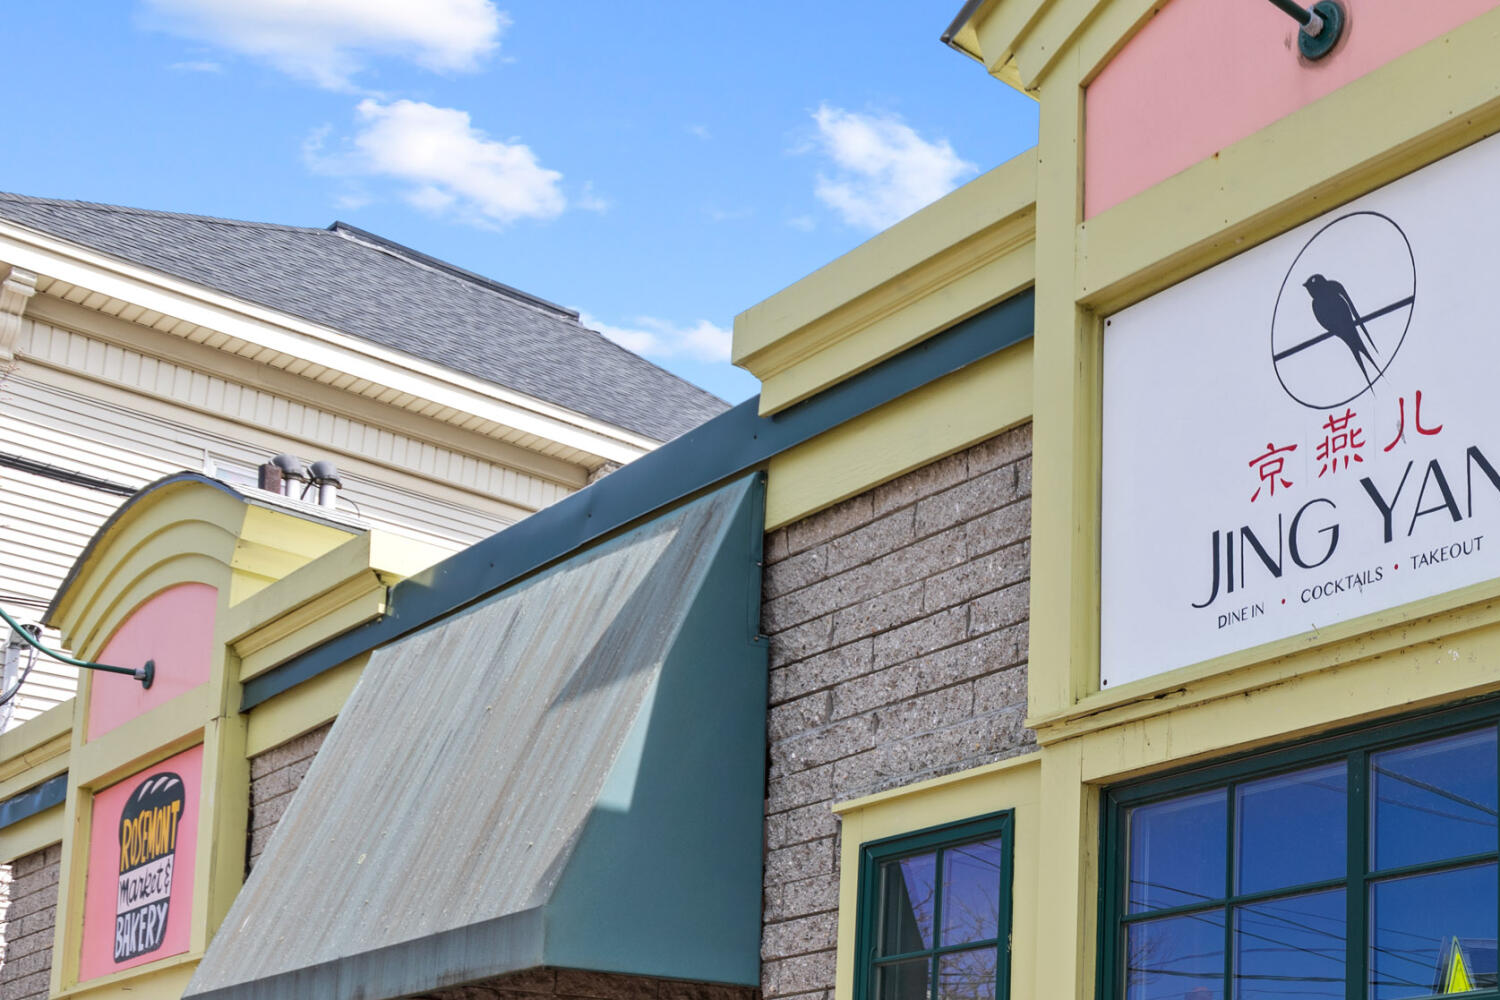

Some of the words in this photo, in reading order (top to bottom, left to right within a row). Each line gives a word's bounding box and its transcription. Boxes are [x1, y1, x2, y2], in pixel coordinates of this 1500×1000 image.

[1248, 390, 1444, 502] 京燕儿
[1191, 497, 1340, 608] JING
[1217, 606, 1249, 629] DINE
[1251, 602, 1265, 618] IN
[1300, 566, 1384, 604] COCKTAILS
[1410, 535, 1484, 570] TAKEOUT
[120, 799, 181, 872] ROSEMONT
[115, 902, 169, 959] BAKERY
